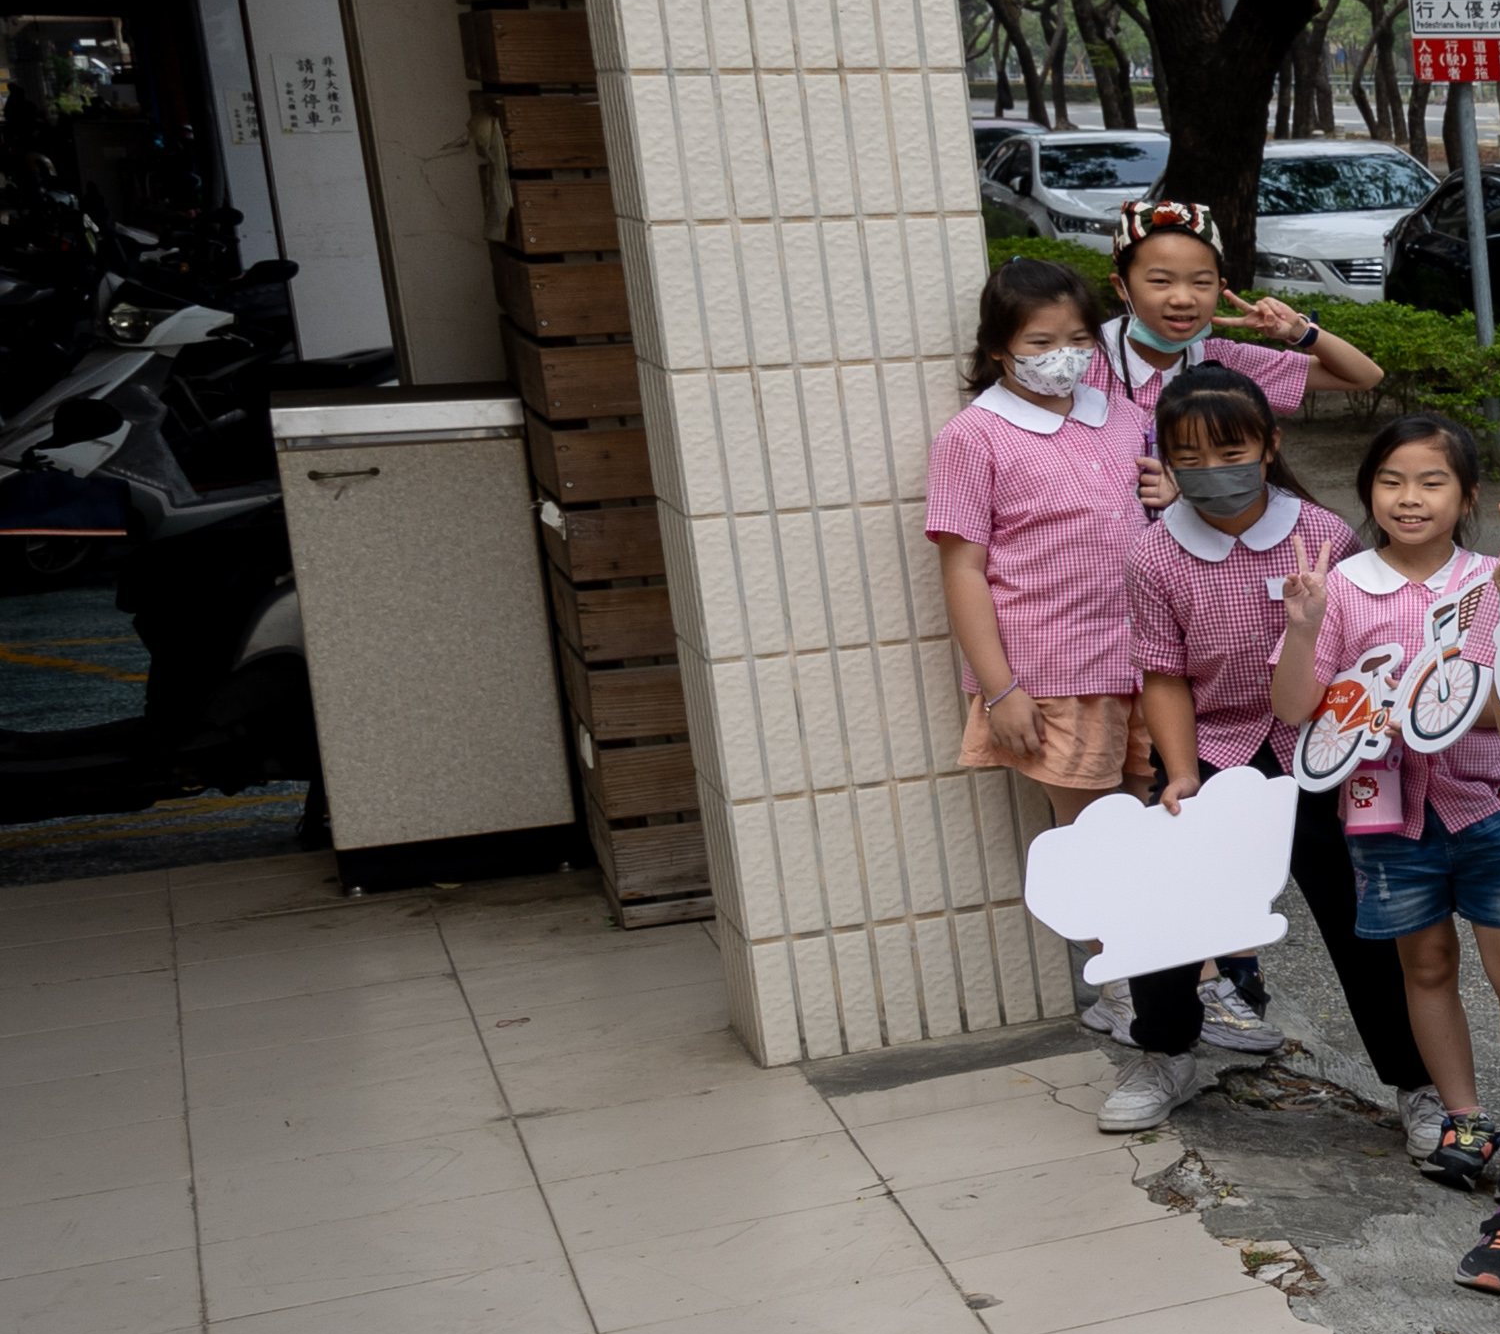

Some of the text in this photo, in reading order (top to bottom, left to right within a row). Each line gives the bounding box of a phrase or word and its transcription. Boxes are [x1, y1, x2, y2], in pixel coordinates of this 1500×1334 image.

[1416, 20, 1454, 29] Pedestrians
[1456, 20, 1471, 29] Have
[1472, 20, 1489, 30] Right
[1491, 20, 1498, 29] of
[296, 58, 324, 127] 請勿停車
